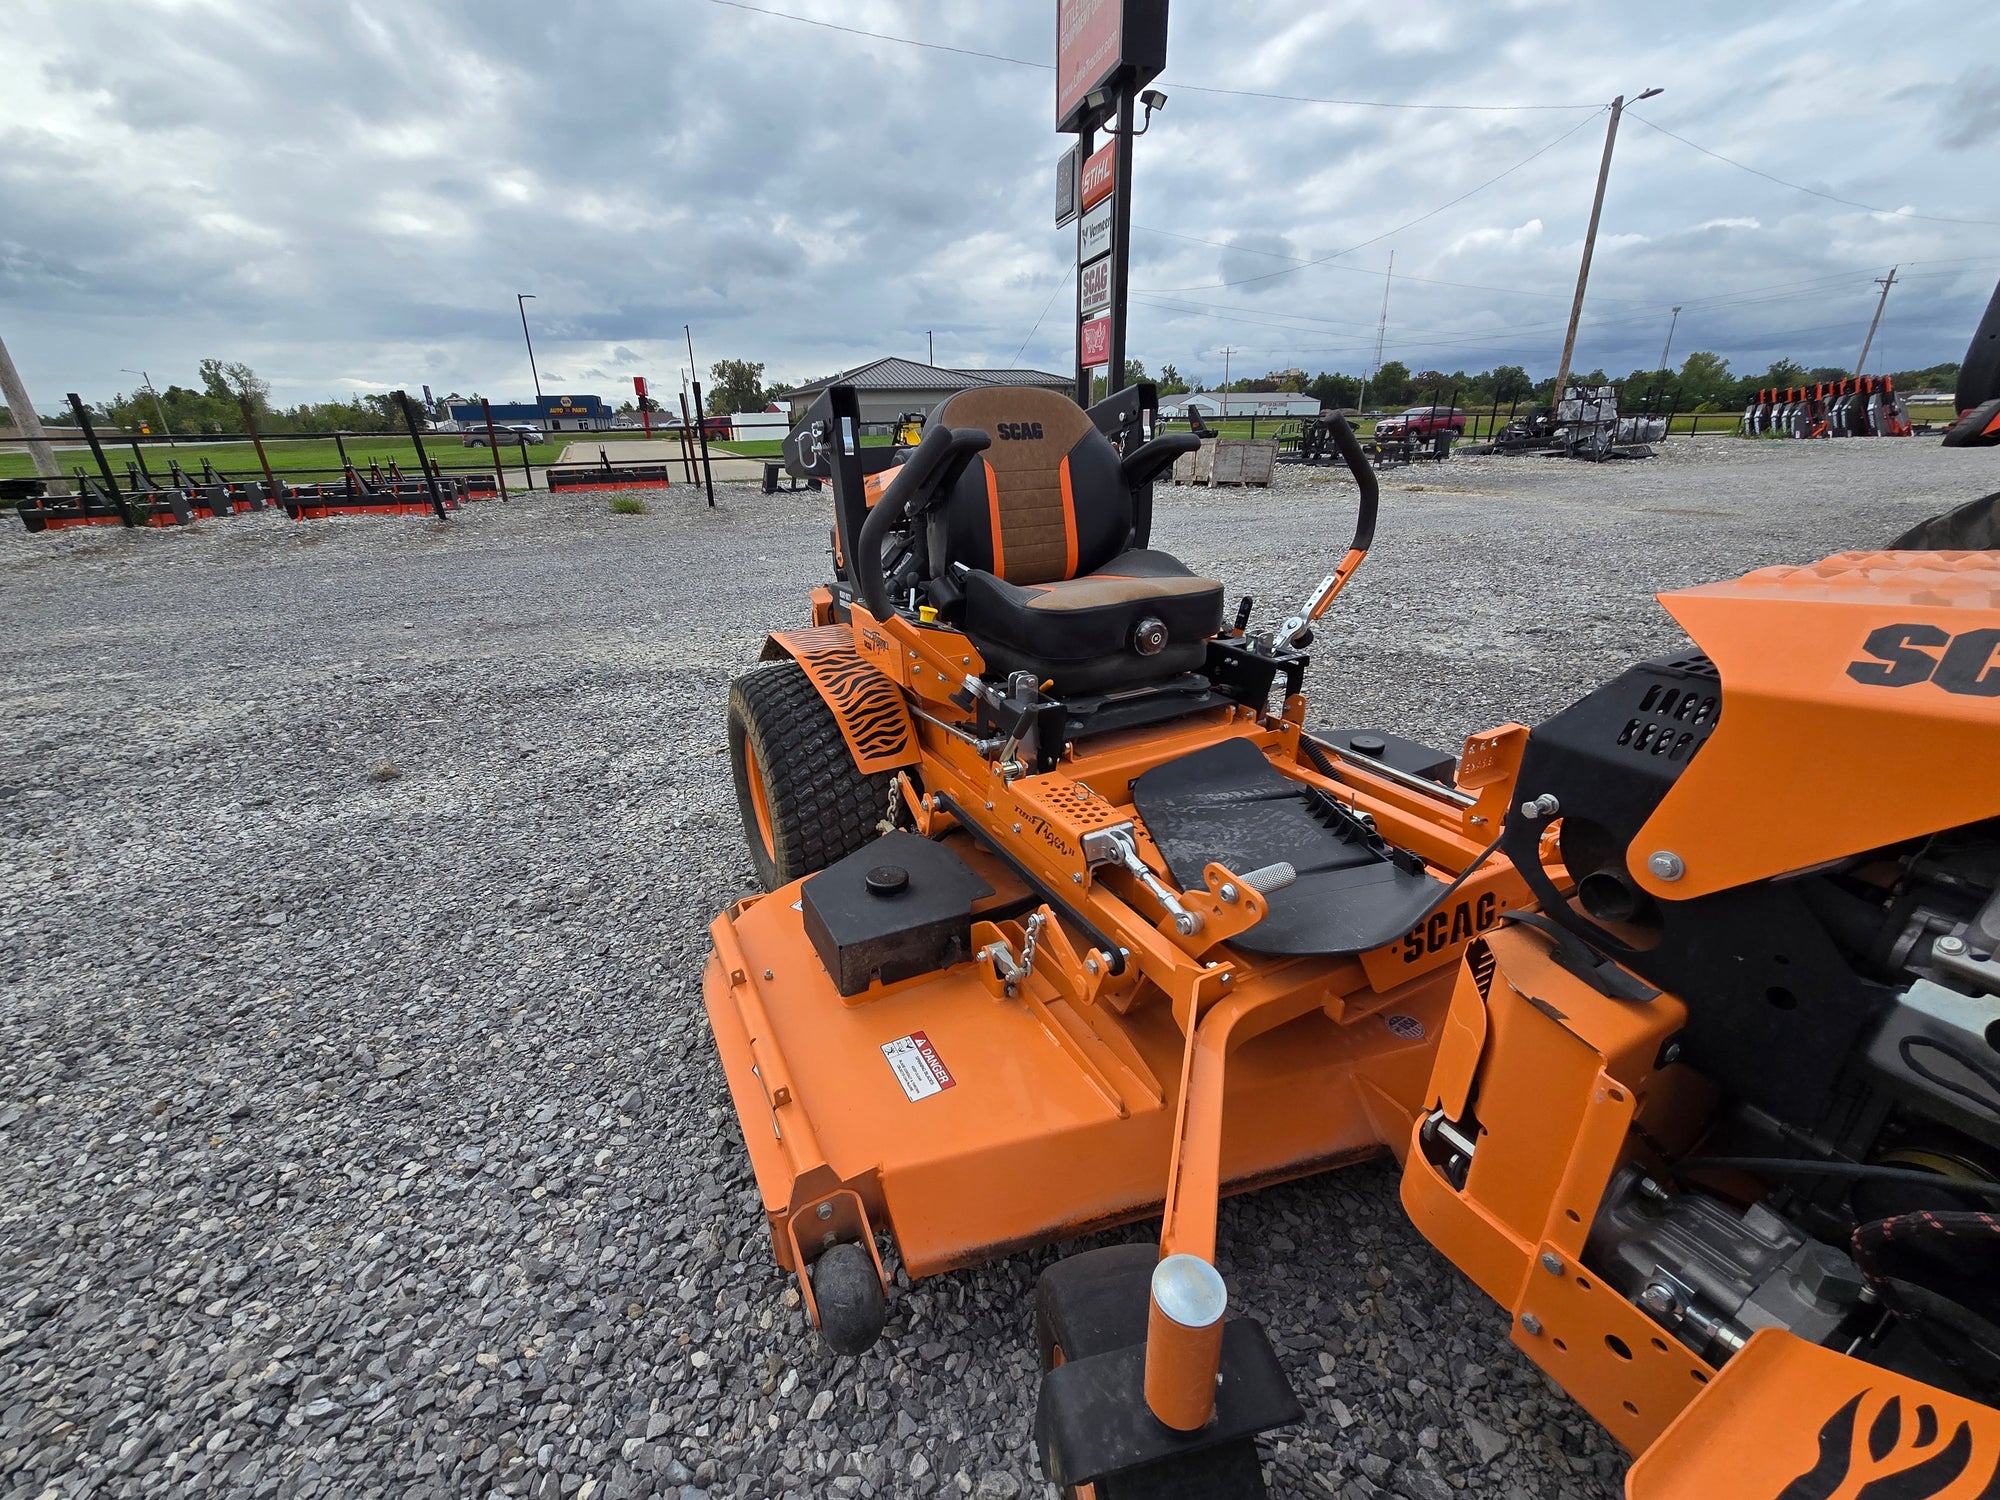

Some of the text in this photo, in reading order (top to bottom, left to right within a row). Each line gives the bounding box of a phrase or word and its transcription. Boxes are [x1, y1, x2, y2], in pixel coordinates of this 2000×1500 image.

[1083, 156, 1110, 194] STIHL
[1083, 263, 1107, 297] SCAG
[997, 422, 1043, 440] SCAG
[1403, 891, 1496, 964] SCAG
[914, 1055, 934, 1085] SPINNING BLADES
[921, 1047, 949, 1083] DANGER
